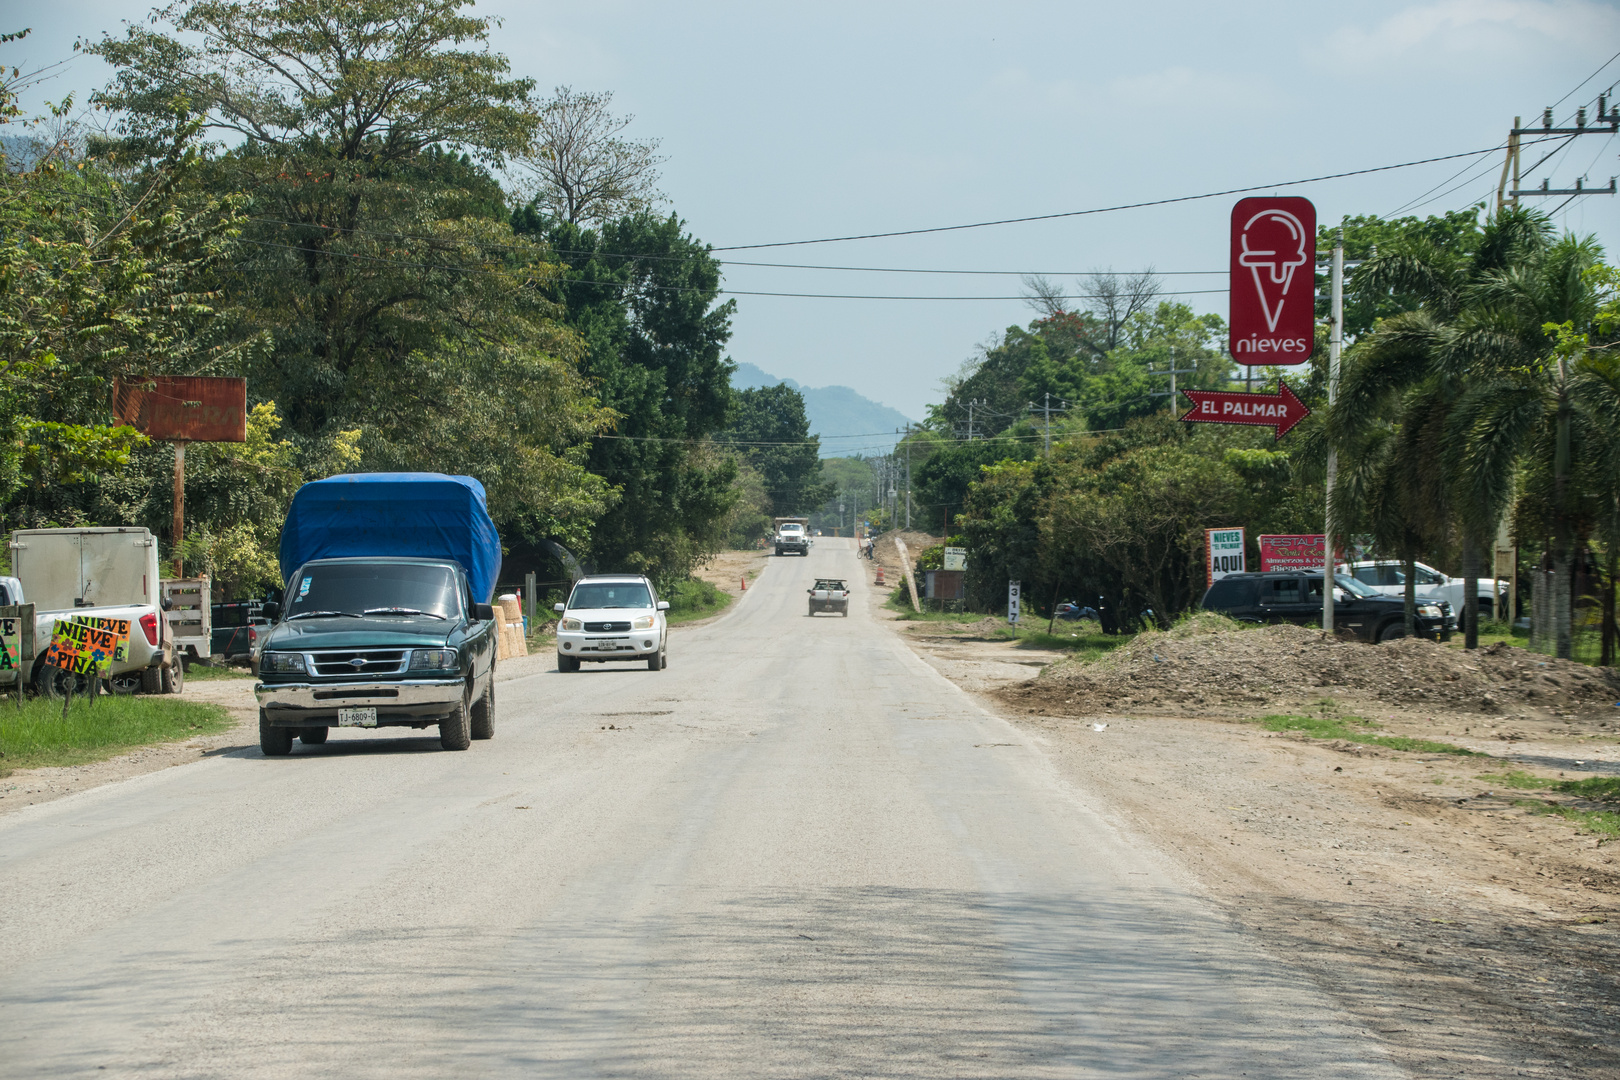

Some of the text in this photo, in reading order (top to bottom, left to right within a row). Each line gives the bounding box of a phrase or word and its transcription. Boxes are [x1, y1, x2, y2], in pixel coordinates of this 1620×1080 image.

[1237, 333, 1306, 353] nieves
[1201, 401, 1287, 417] EL PALMAR
[1213, 531, 1240, 543] NIEVES
[1213, 552, 1243, 573] AQUÍ
[59, 621, 113, 648] NIEVE
[75, 643, 87, 652] DE
[56, 652, 98, 676] PIÑA
[339, 712, 376, 722] TJ-6809-G
